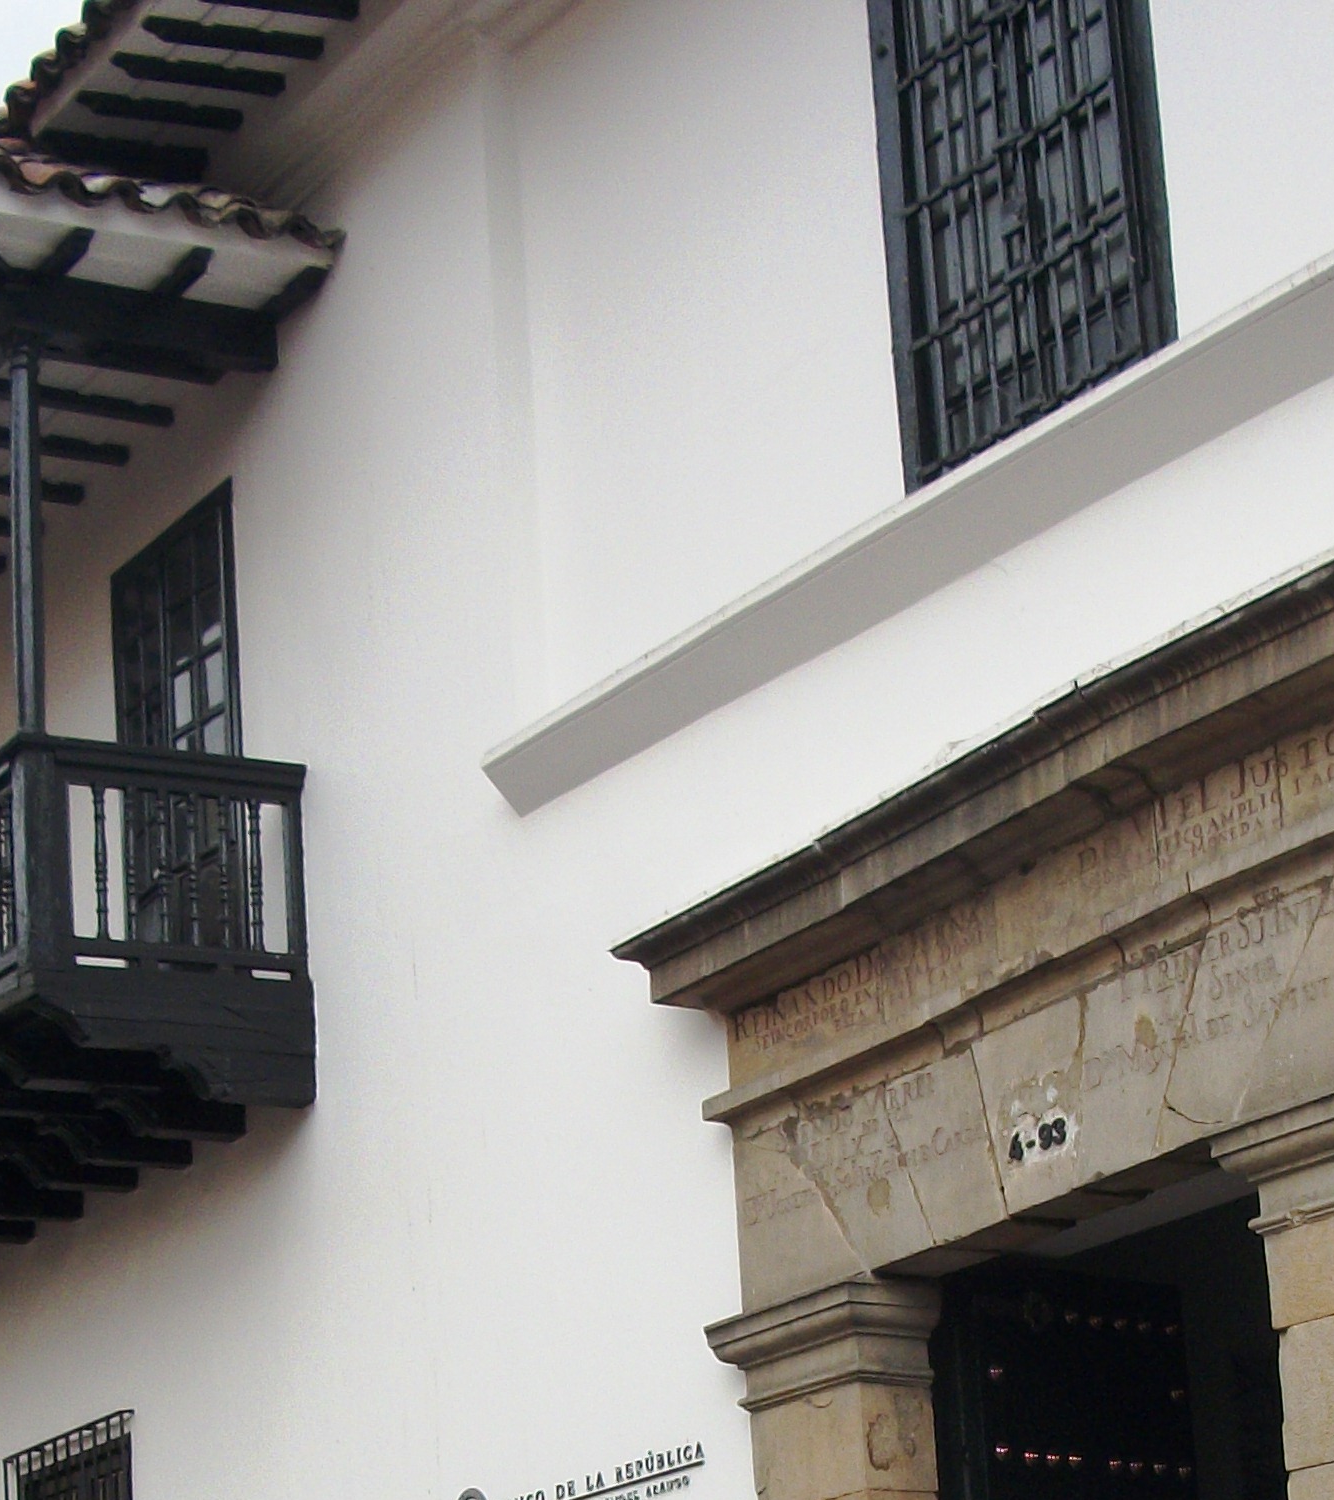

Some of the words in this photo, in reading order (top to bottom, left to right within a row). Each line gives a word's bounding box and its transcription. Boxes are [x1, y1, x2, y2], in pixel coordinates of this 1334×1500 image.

[1008, 1117, 1067, 1161] 4-93
[555, 1480, 576, 1500] DE
[586, 1471, 605, 1491] LA
[615, 1441, 705, 1484] REPÚBLICA
